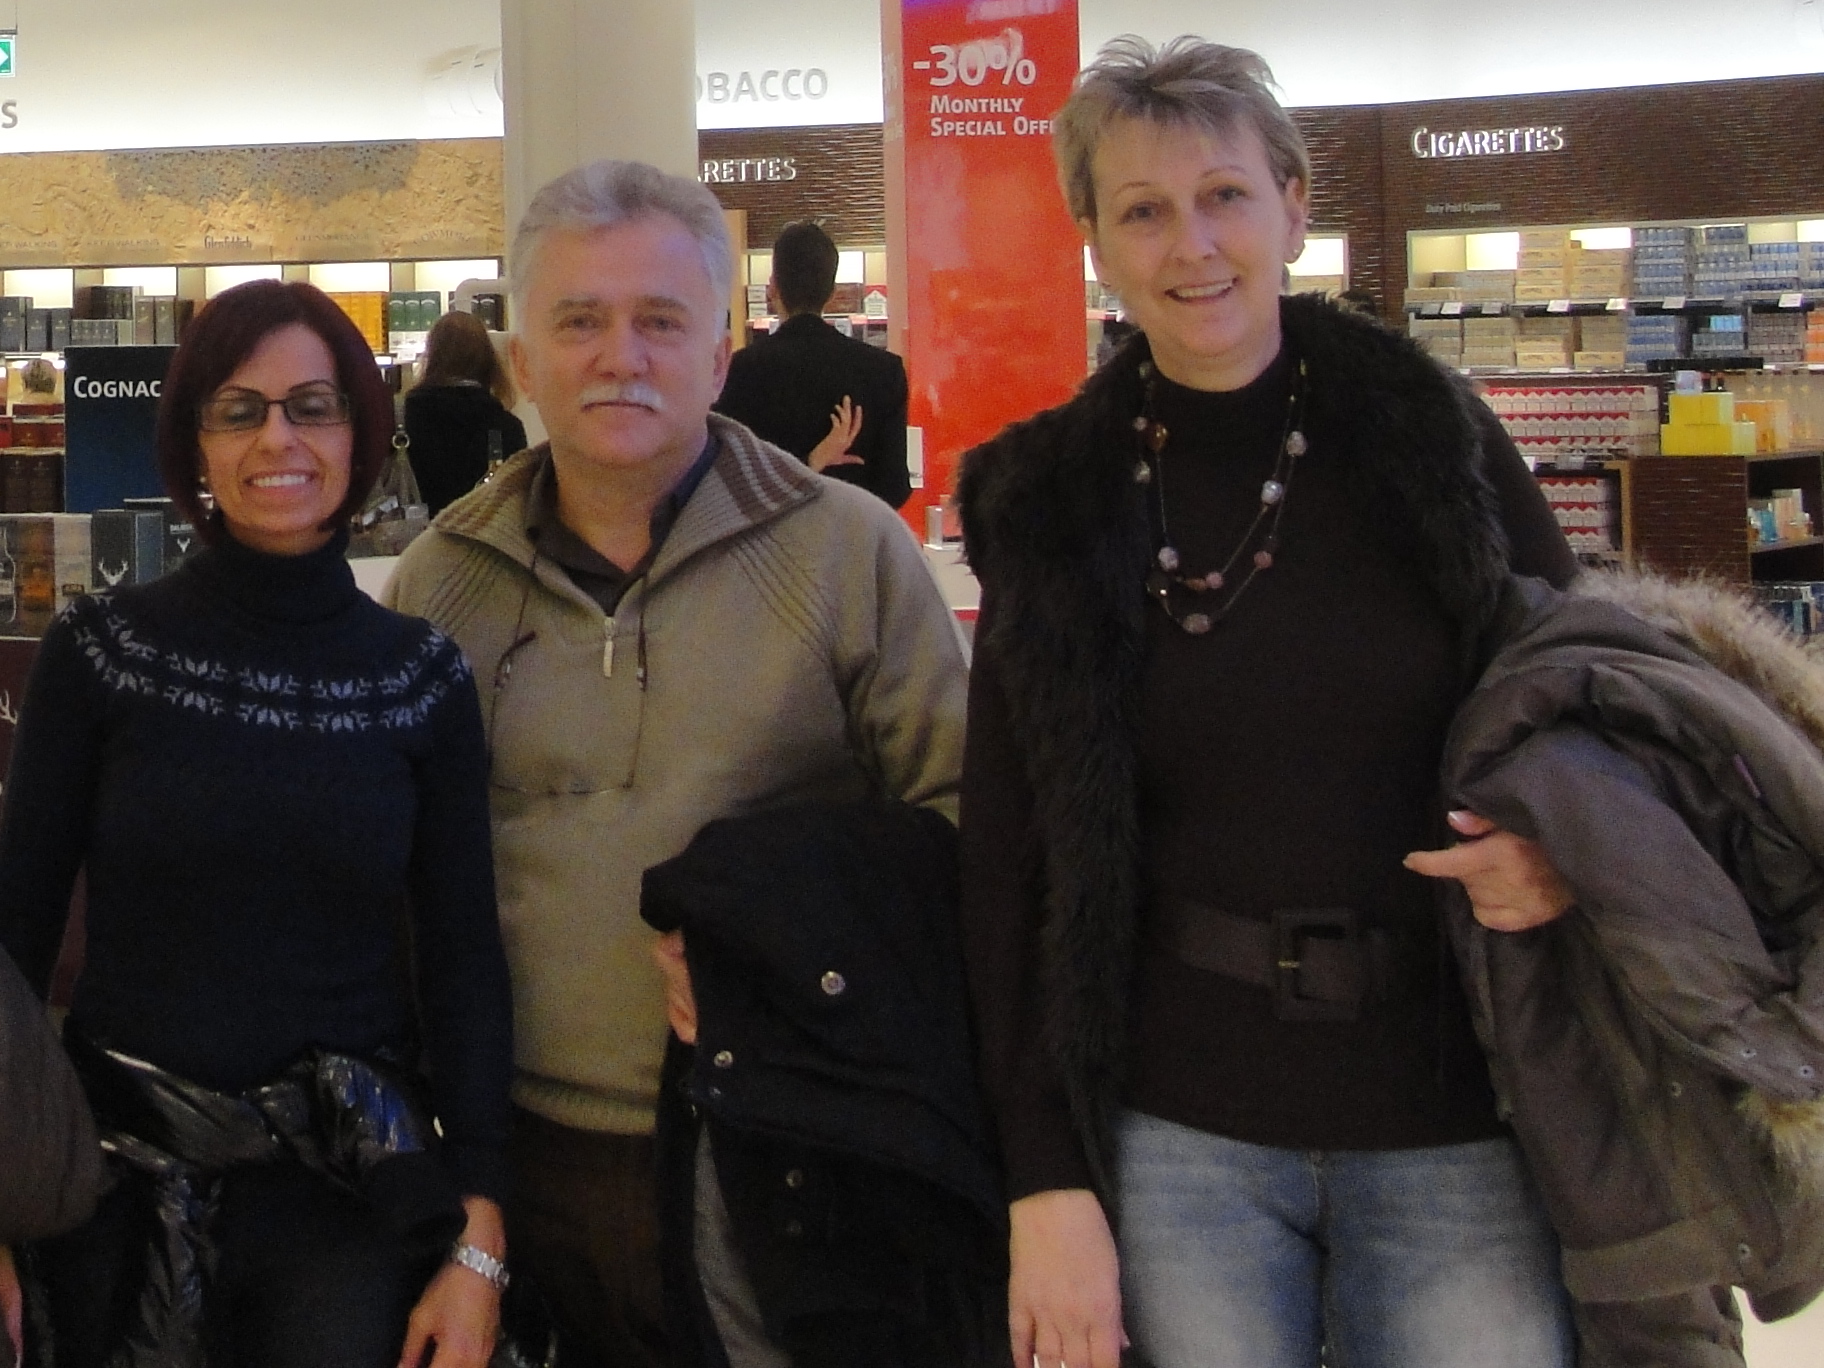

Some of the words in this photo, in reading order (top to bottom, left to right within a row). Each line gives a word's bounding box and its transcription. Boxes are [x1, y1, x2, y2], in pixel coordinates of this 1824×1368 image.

[913, 42, 1037, 86] -30%
[697, 68, 829, 103] BACCO
[930, 95, 1024, 114] MONTHLY
[930, 117, 1007, 137] SPECIAL
[1013, 116, 1055, 136] OFF
[1411, 126, 1564, 159] CIGARETTES
[697, 157, 797, 183] RETTES
[73, 375, 162, 399] COGNAC
